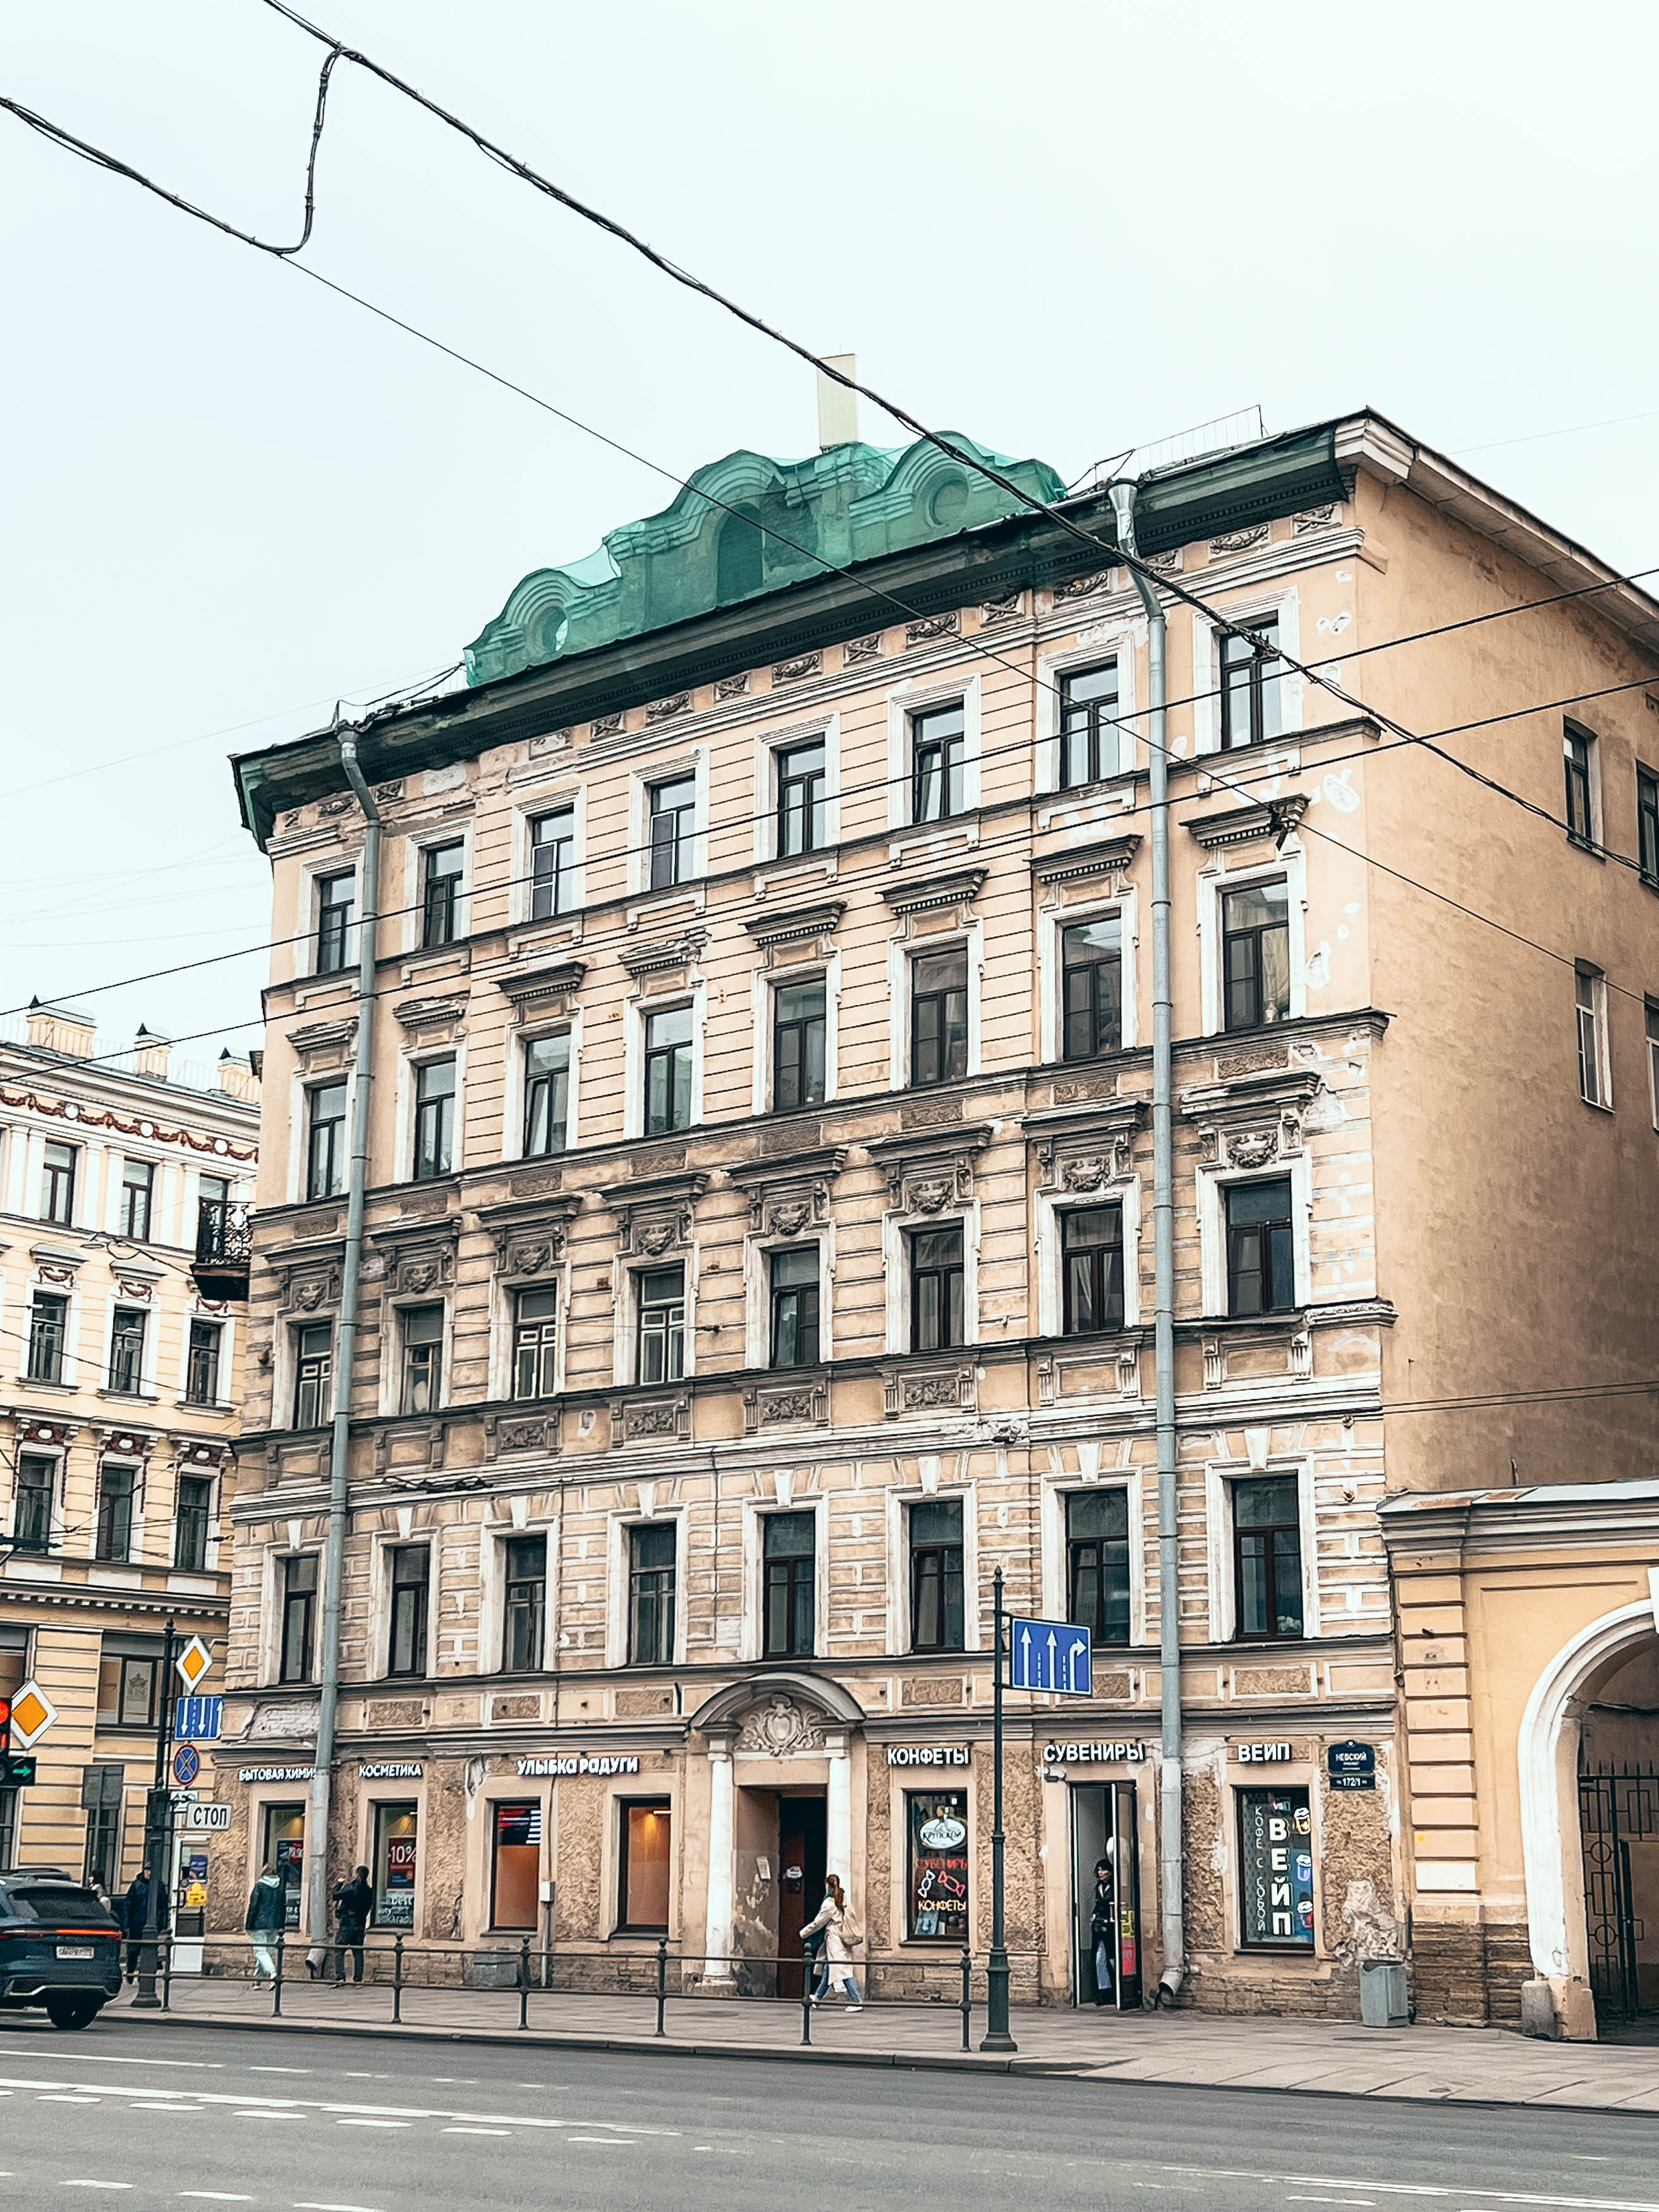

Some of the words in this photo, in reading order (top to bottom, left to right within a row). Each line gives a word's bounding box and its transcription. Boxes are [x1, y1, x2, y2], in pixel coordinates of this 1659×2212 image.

[887, 1748, 969, 1765] КОНФЕТЫ
[1043, 1744, 1143, 1762] СУВЕНИРЫ
[1239, 1742, 1290, 1761] ВЕЙП
[239, 1768, 284, 1781] БЫТОВАЯ
[359, 1765, 421, 1777] КОСМЕТИКА
[193, 1807, 228, 1826] СТОП
[1255, 1806, 1263, 1849] КОФЕ
[1269, 1818, 1291, 1935] ВЕЙП
[918, 1900, 966, 1911] КОНФЕТЫ
[1256, 1876, 1266, 1931] СОБОЙ
